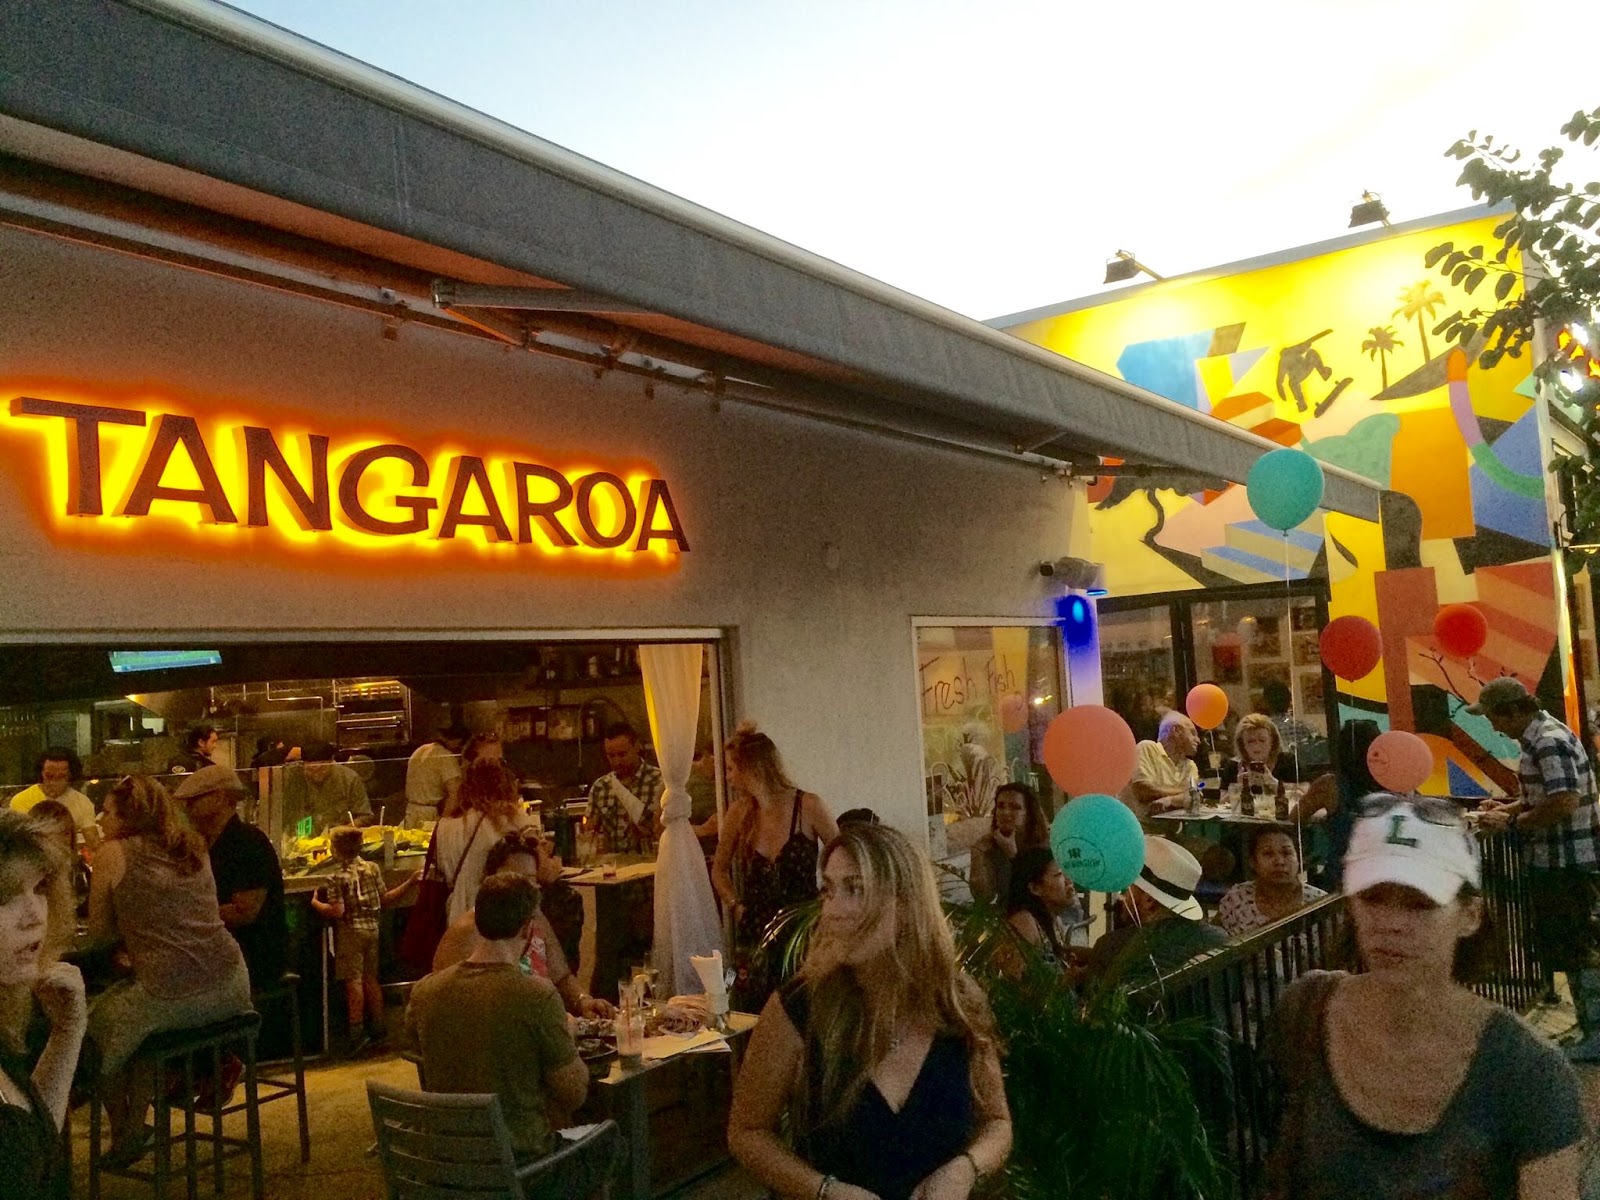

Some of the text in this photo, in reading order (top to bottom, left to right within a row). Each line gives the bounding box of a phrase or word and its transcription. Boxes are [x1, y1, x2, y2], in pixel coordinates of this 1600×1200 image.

[11, 397, 690, 553] TANGAROA
[918, 654, 1016, 717] Fresh Fish
[1385, 815, 1417, 847] L
